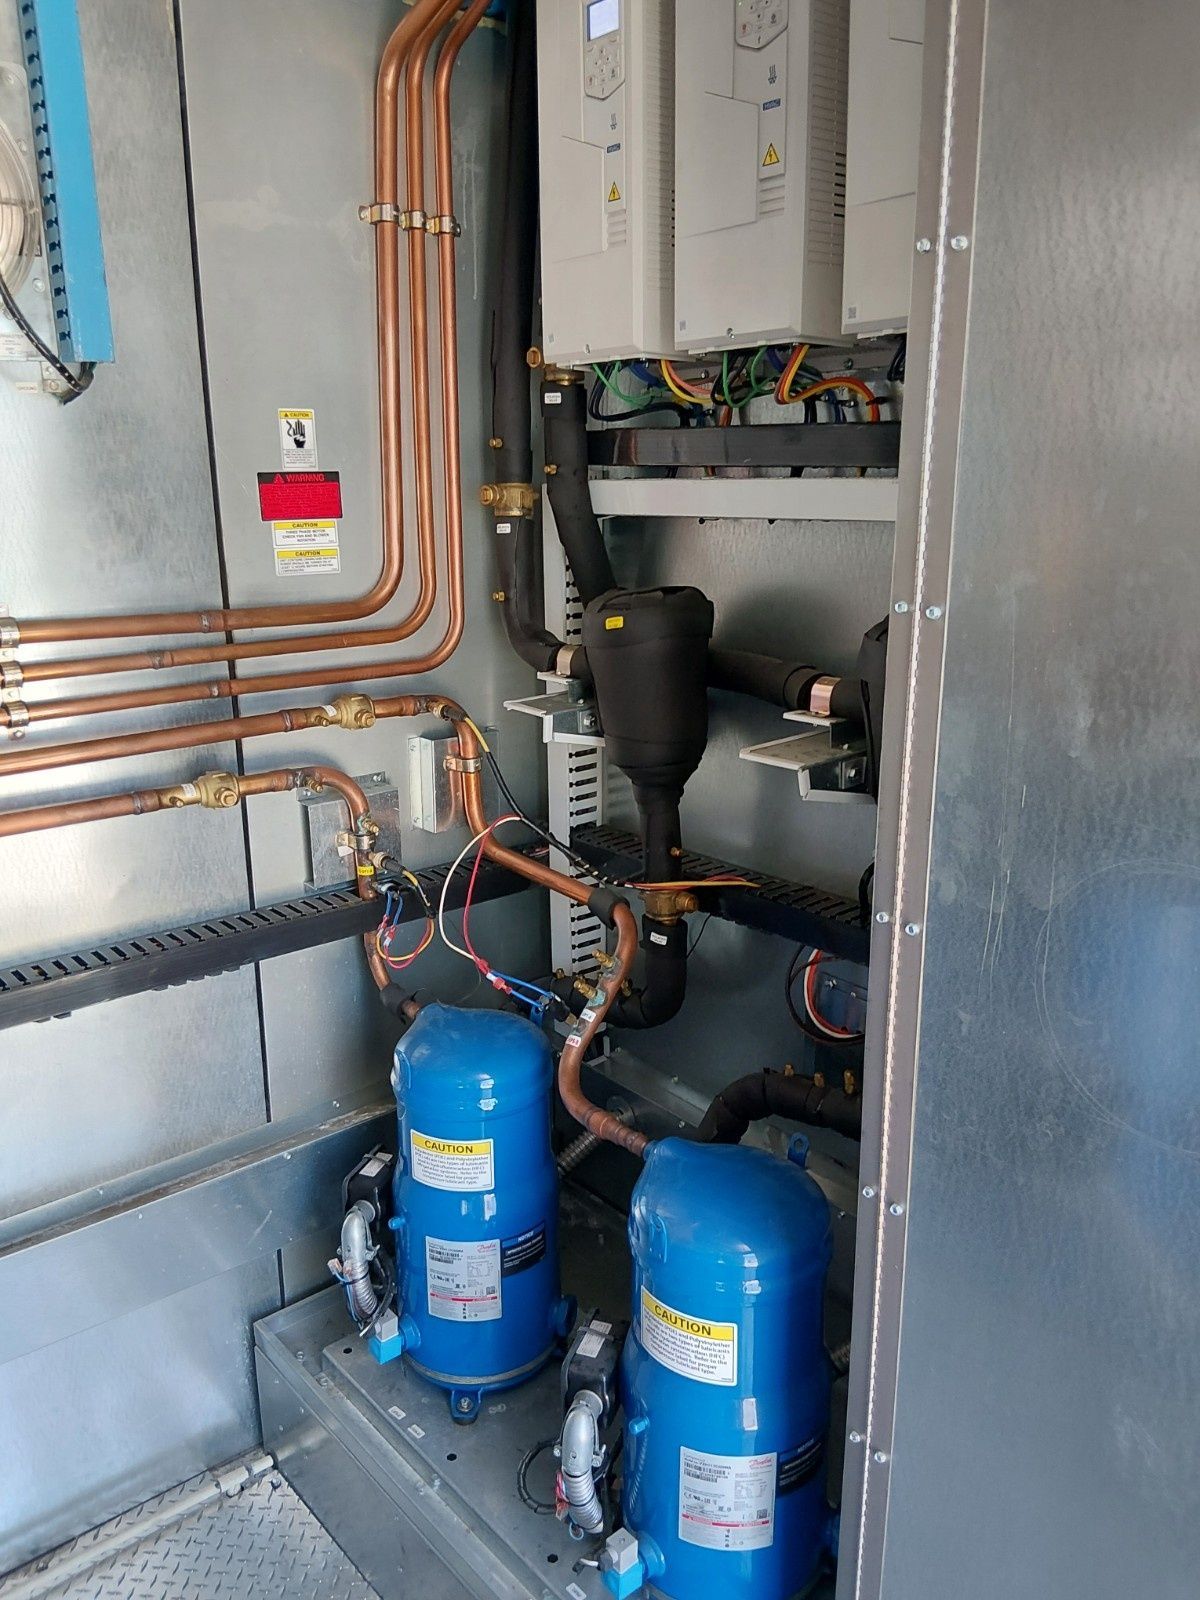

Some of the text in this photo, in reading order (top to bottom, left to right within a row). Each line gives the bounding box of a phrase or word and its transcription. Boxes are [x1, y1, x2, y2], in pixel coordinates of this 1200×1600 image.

[286, 474, 325, 482] WARNING
[424, 1140, 473, 1153] CAUTION
[654, 1305, 711, 1335] CAUTION
[679, 1331, 688, 1340] and
[680, 1336, 694, 1347] types
